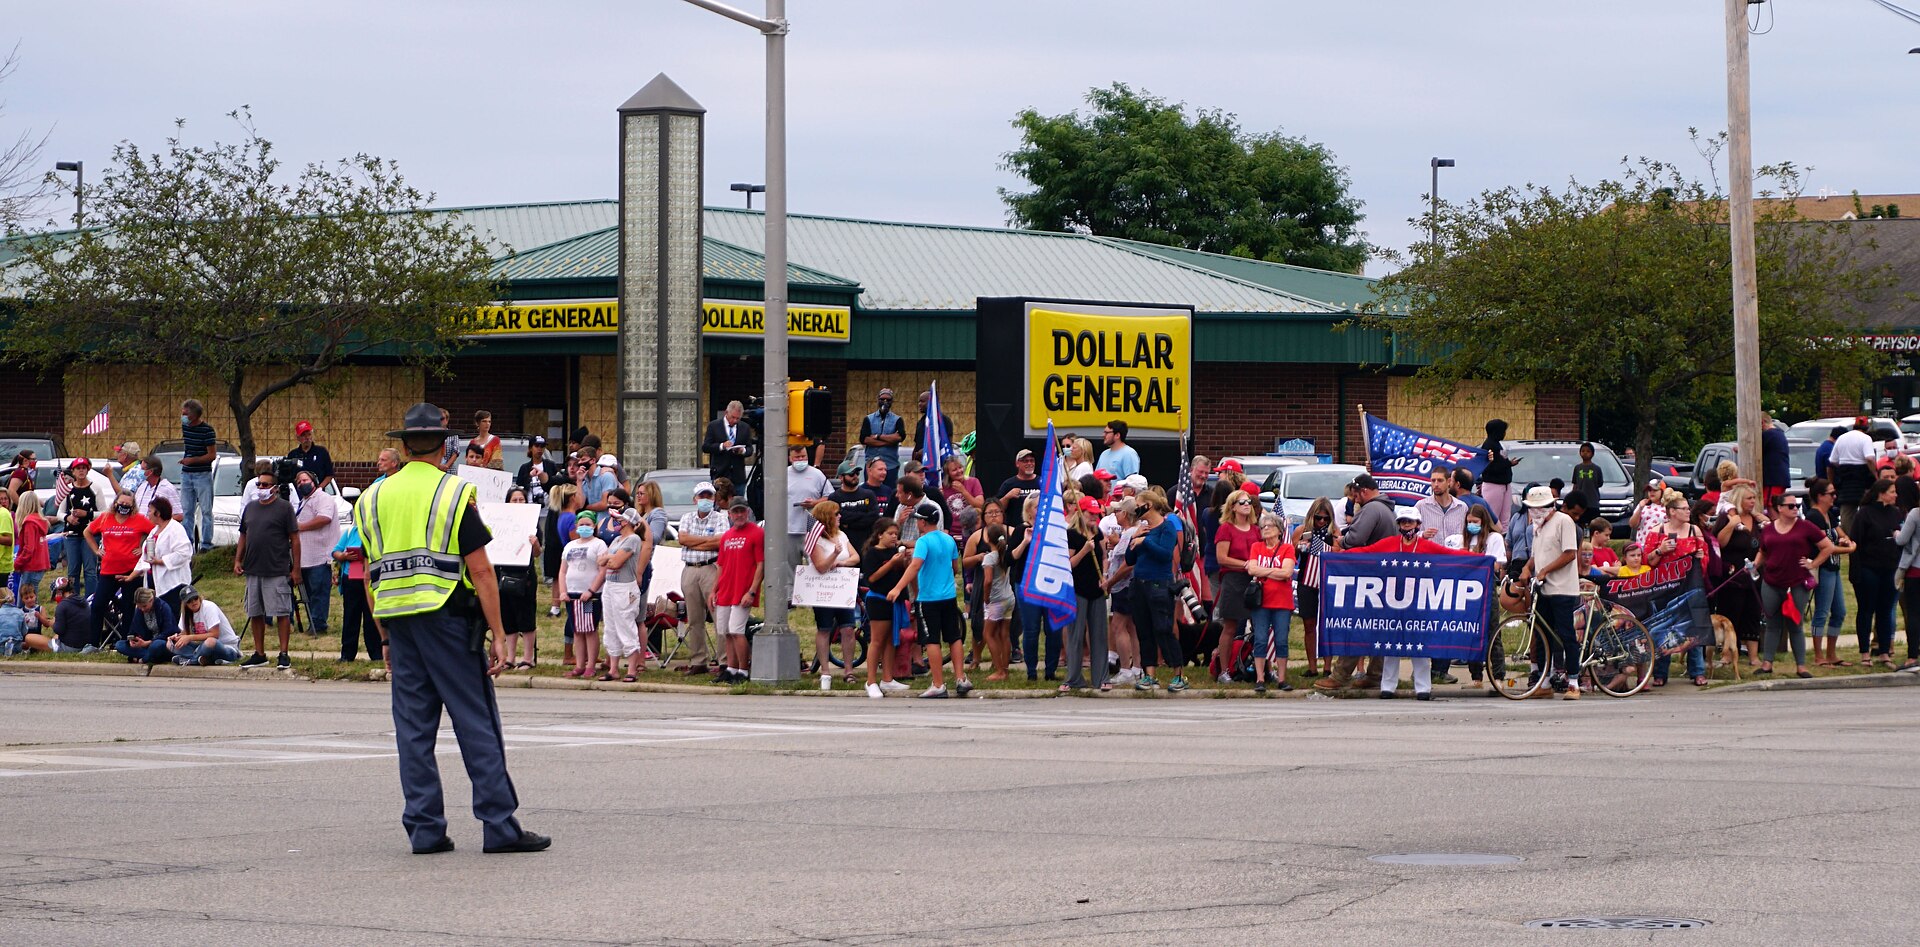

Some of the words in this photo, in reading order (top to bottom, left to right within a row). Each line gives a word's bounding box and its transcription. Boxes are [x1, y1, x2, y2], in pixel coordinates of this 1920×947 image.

[527, 306, 618, 329] GENERAL
[1052, 328, 1174, 370] DOLLAR
[1043, 373, 1181, 414] GENERAL
[1382, 457, 1433, 474] 2020
[1378, 480, 1407, 490] LIBERALS
[1407, 482, 1426, 493] CRY
[1607, 556, 1692, 594] TRUMP
[1327, 575, 1484, 611] TRUMP
[1631, 588, 1653, 597] America
[1325, 617, 1353, 629] MAKE
[1354, 618, 1403, 631] AMERICA
[1405, 619, 1439, 632] GREAT
[1441, 620, 1480, 634] AGAIN!
